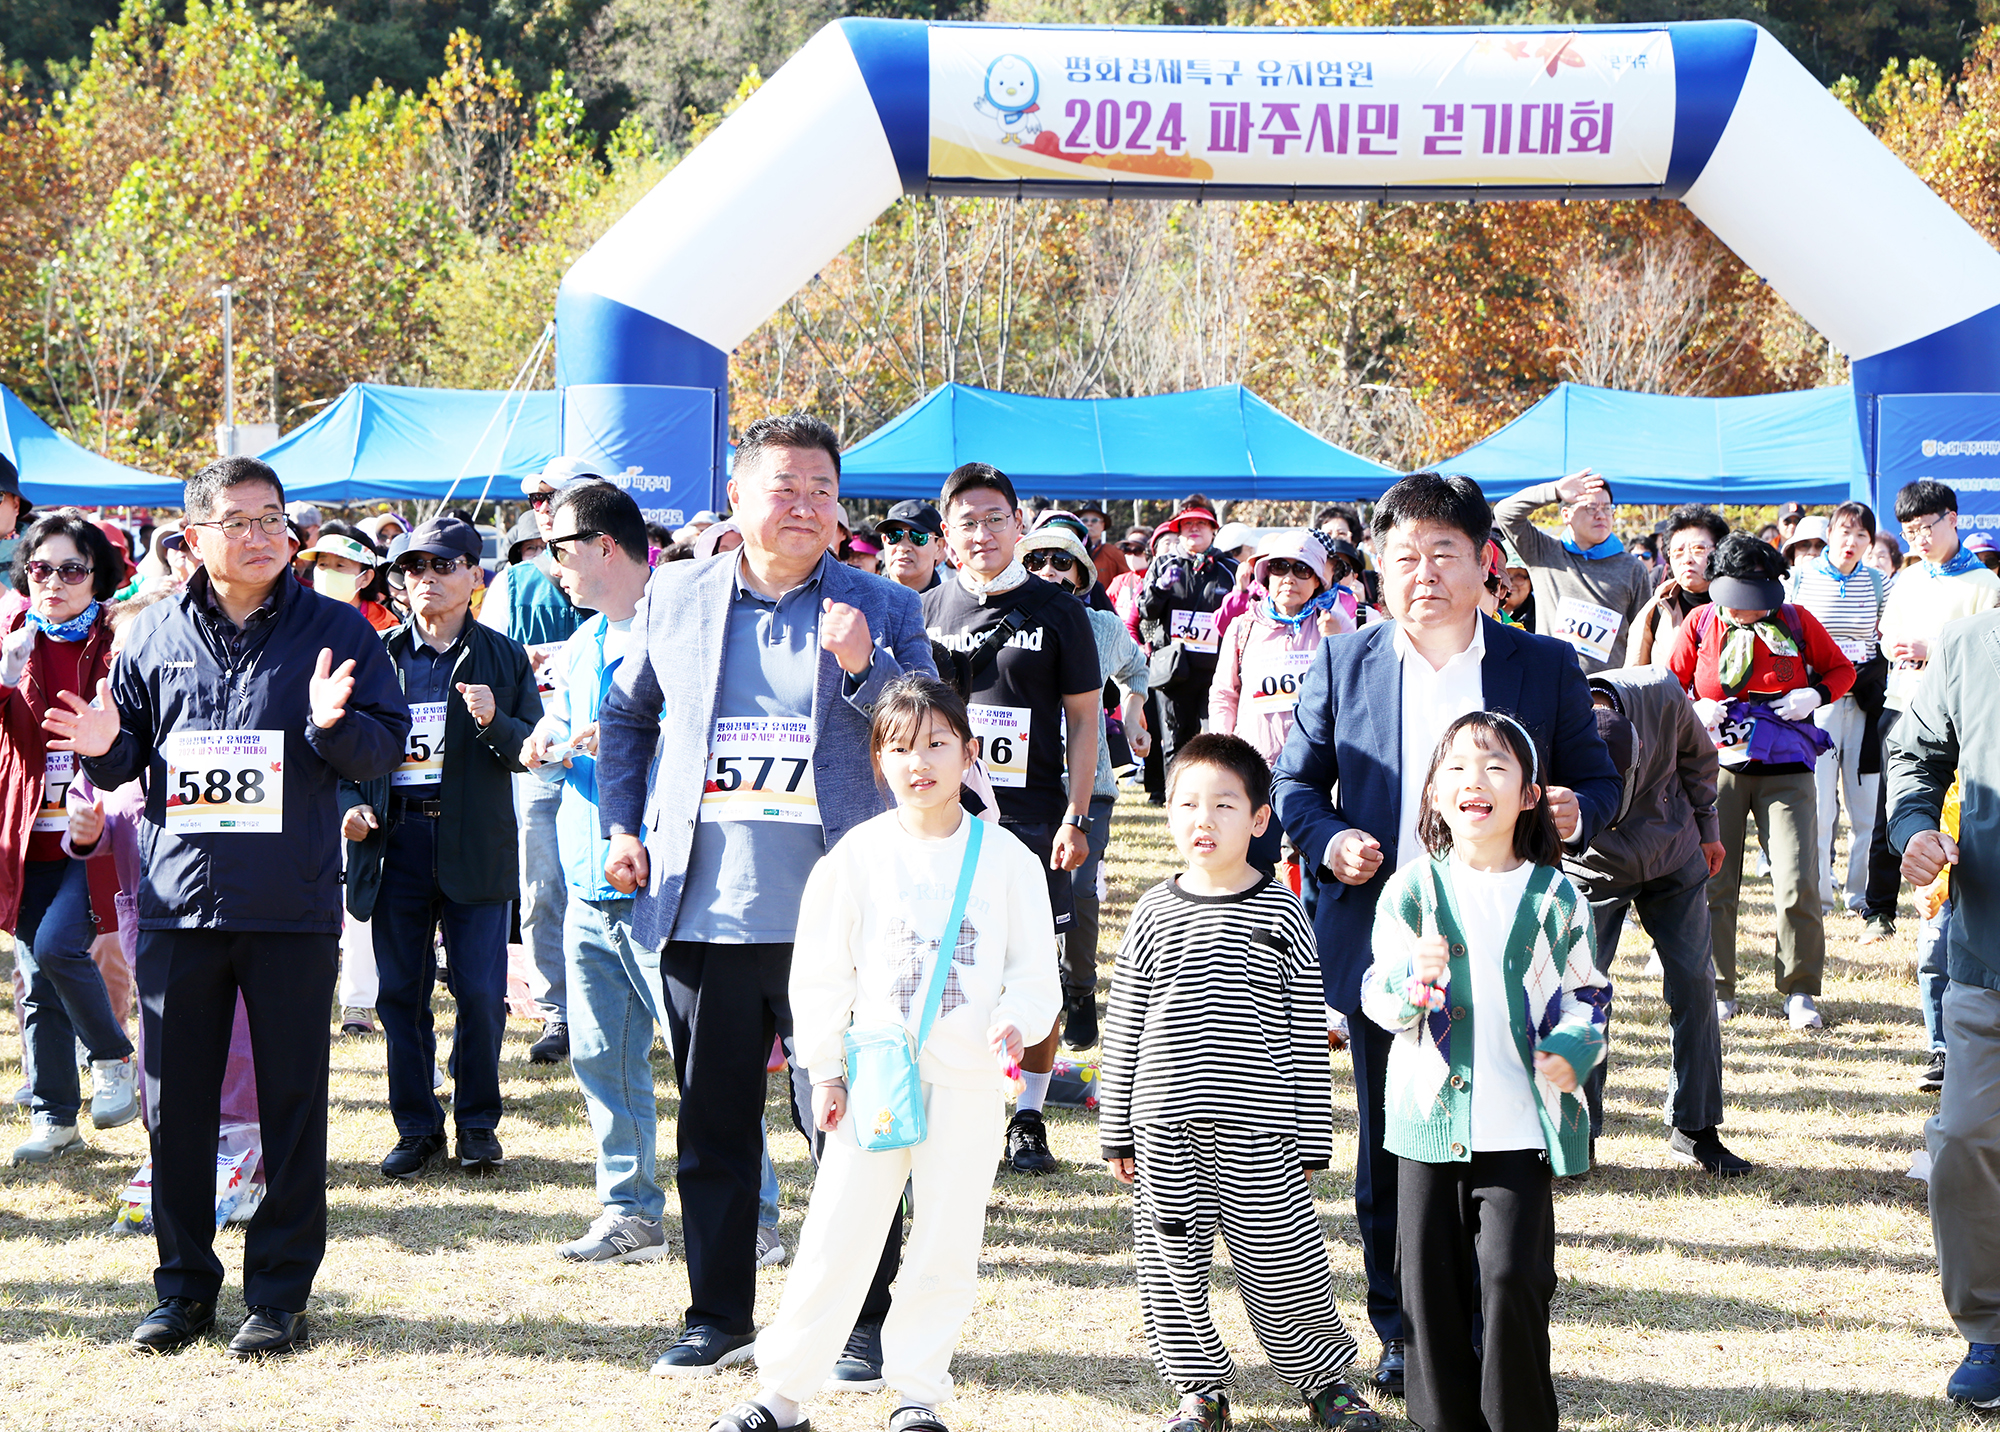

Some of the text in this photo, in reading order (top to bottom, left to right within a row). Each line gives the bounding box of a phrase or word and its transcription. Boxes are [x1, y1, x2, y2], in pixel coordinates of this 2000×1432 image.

[1065, 56, 1374, 87] 평화경제특구 유치염원
[1065, 99, 1614, 156] 2024 파주시민 걷기대회
[633, 476, 671, 491] 파주시
[1178, 625, 1211, 641] 397
[1563, 617, 1608, 643] 307
[716, 733, 737, 742] 2024
[741, 732, 775, 742] 파주시민
[717, 722, 807, 732] 평화경제특구 유치염원
[198, 746, 230, 755] 파주시민
[233, 746, 267, 755] 걷기대회
[226, 735, 260, 745] 유치염원
[716, 756, 808, 792] 577
[178, 768, 265, 805] 588
[914, 883, 991, 914] Ribon
